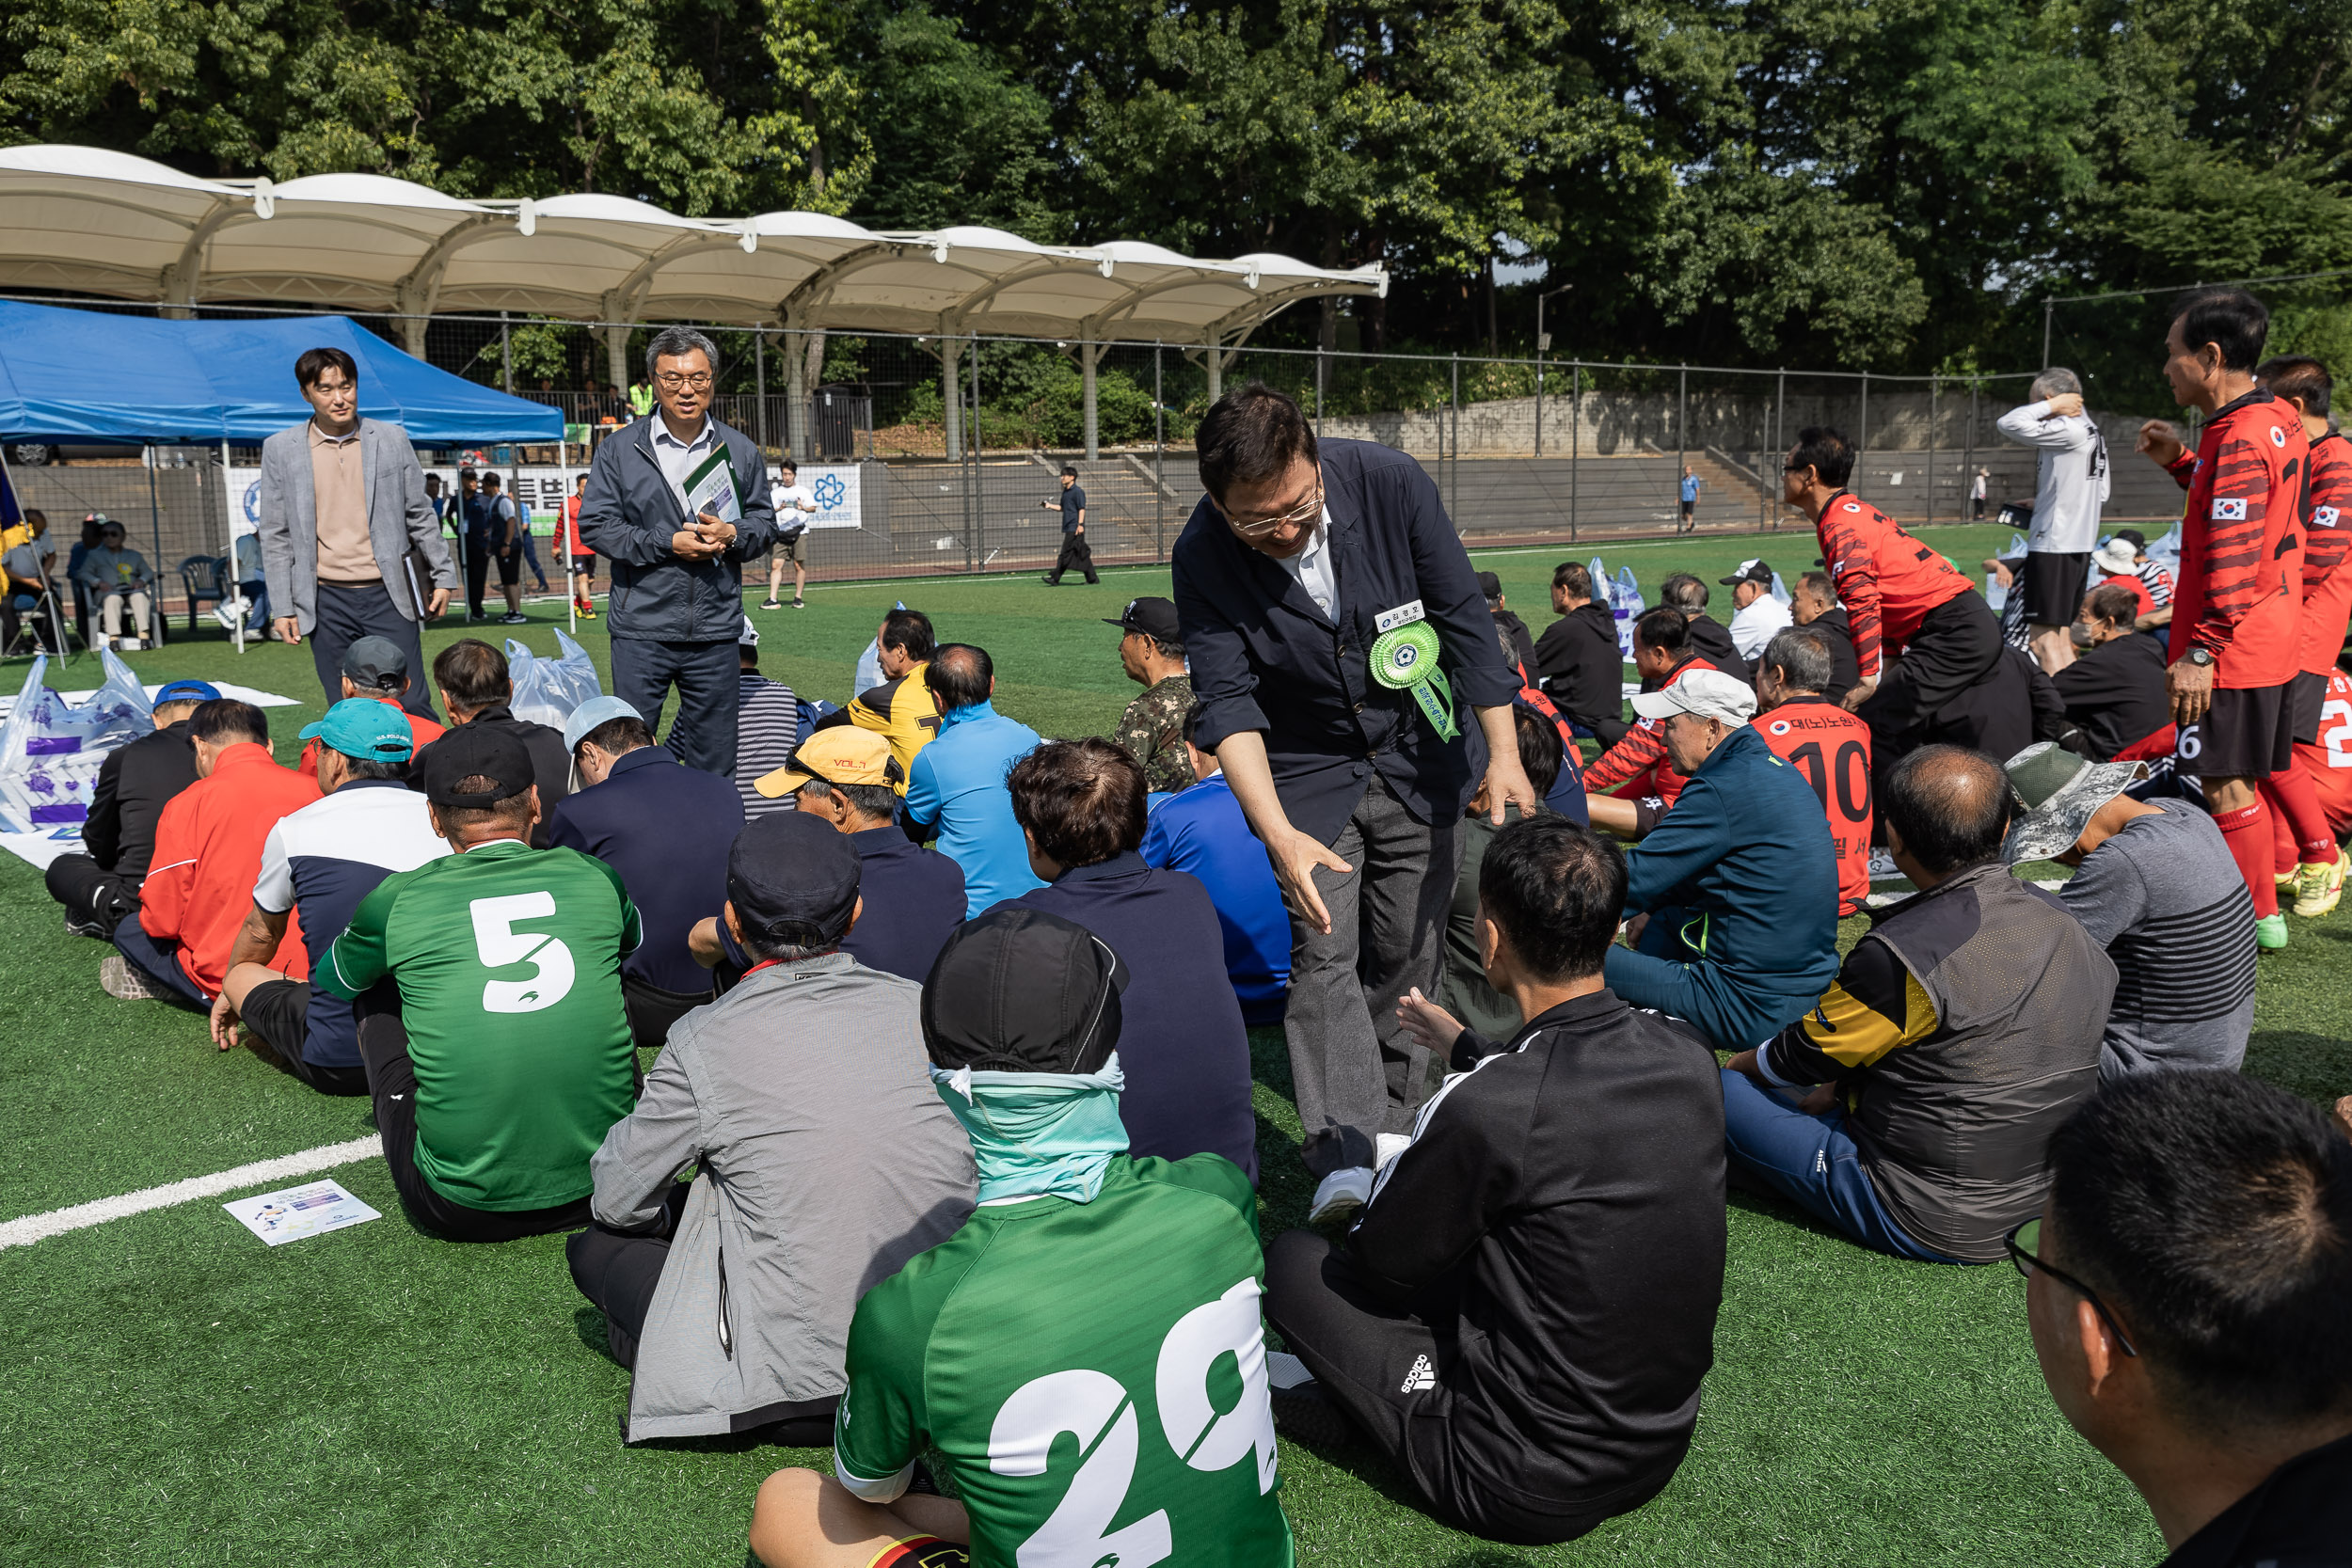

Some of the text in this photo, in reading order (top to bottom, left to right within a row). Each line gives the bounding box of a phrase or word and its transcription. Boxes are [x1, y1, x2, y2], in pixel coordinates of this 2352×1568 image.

[1788, 739, 1872, 823] 10
[469, 890, 576, 1014] 5
[987, 1275, 1278, 1568] 29
[1401, 1354, 1428, 1393] adidas
